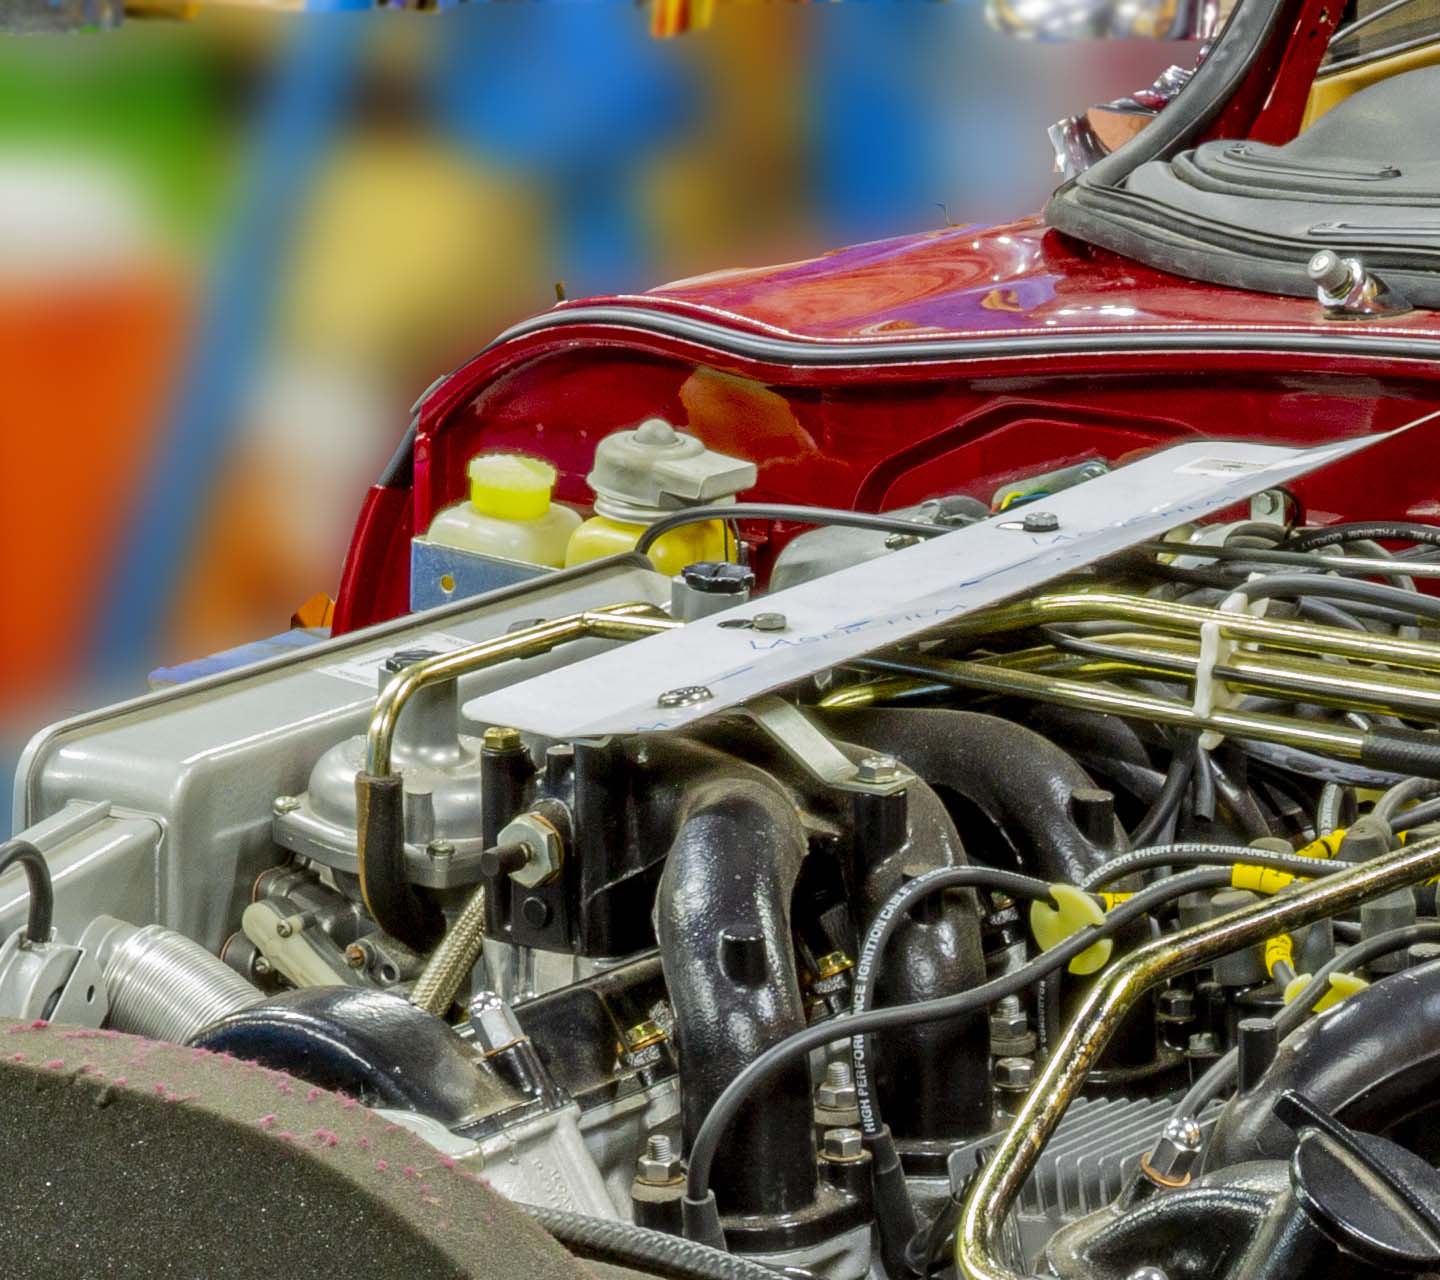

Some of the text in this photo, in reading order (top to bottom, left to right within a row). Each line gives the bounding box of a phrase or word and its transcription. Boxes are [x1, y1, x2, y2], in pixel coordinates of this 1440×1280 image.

[1134, 844, 1171, 860] HIGH
[1173, 842, 1280, 860] PERFORMANCE
[1281, 852, 1348, 868] IGNITION
[852, 887, 913, 1134] HIGH PERFORNCE IGNITION CABLE
